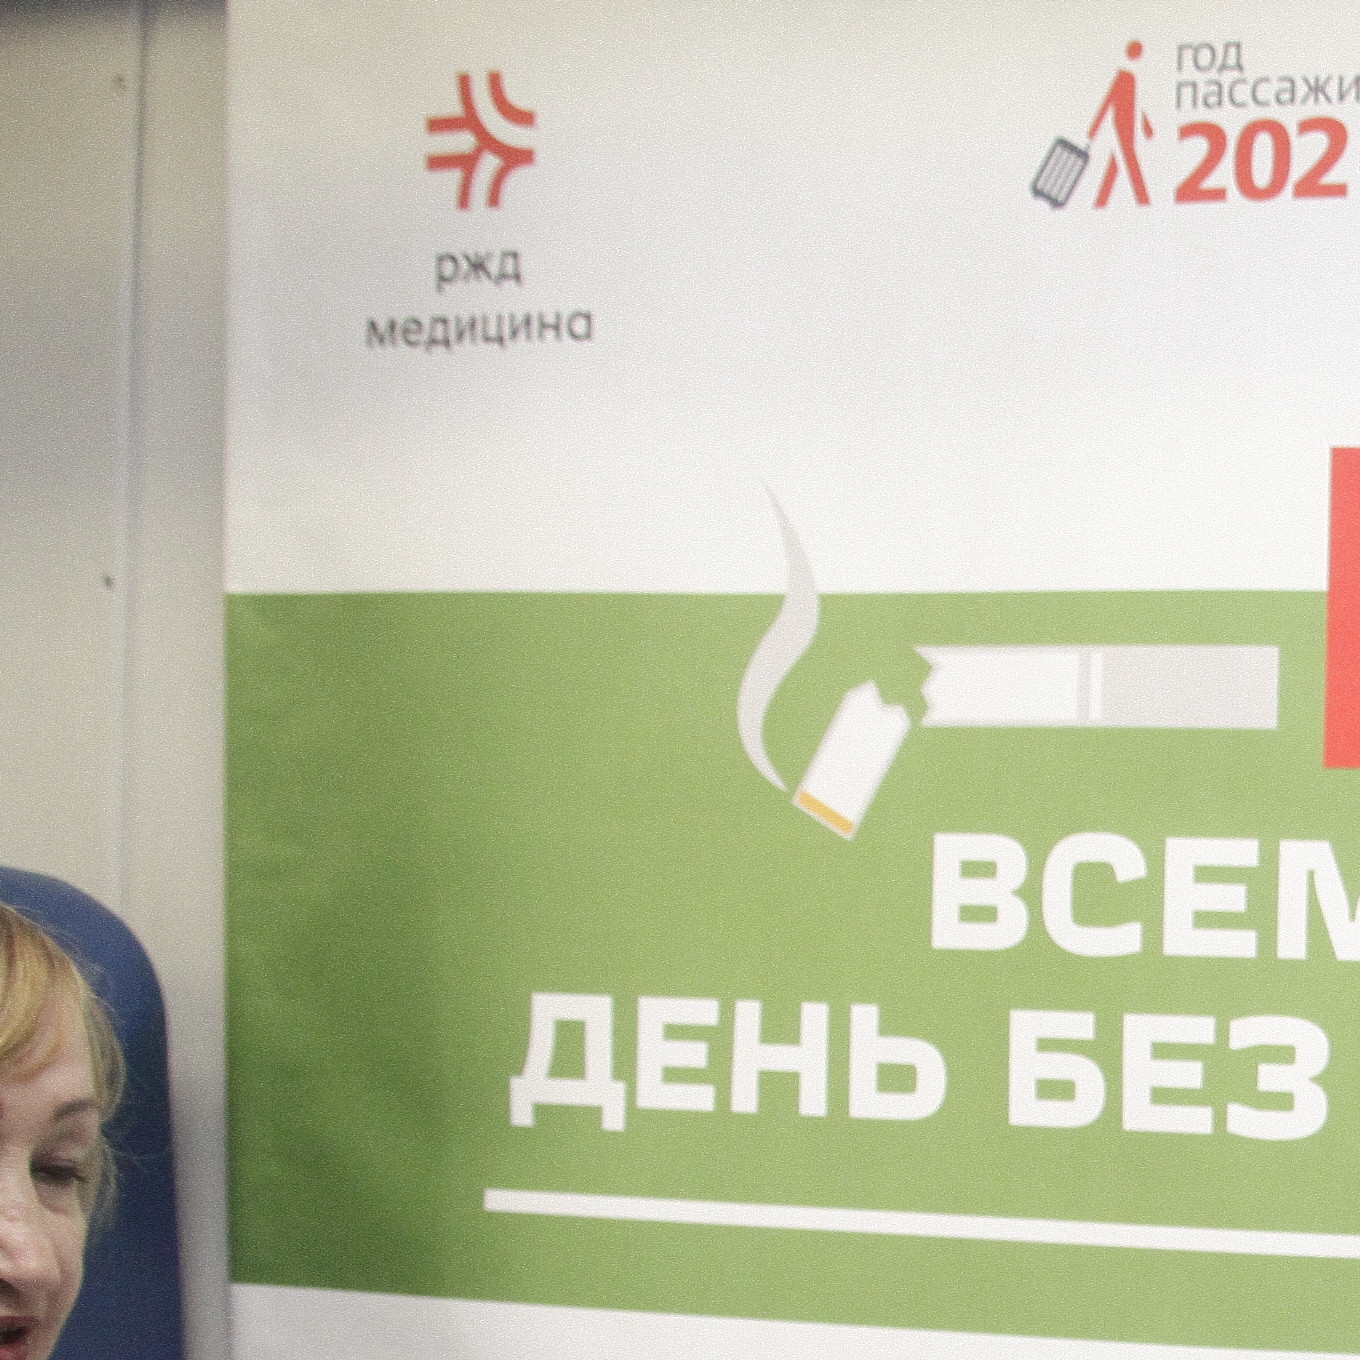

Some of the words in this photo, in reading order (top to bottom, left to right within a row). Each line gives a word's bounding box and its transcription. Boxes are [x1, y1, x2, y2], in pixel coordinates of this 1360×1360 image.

[1175, 40, 1244, 76] год
[435, 249, 523, 292] ржд
[365, 305, 594, 350] медицина
[509, 991, 948, 1132] ДЕНЬ
[1007, 1008, 1332, 1141] БЕЗ
